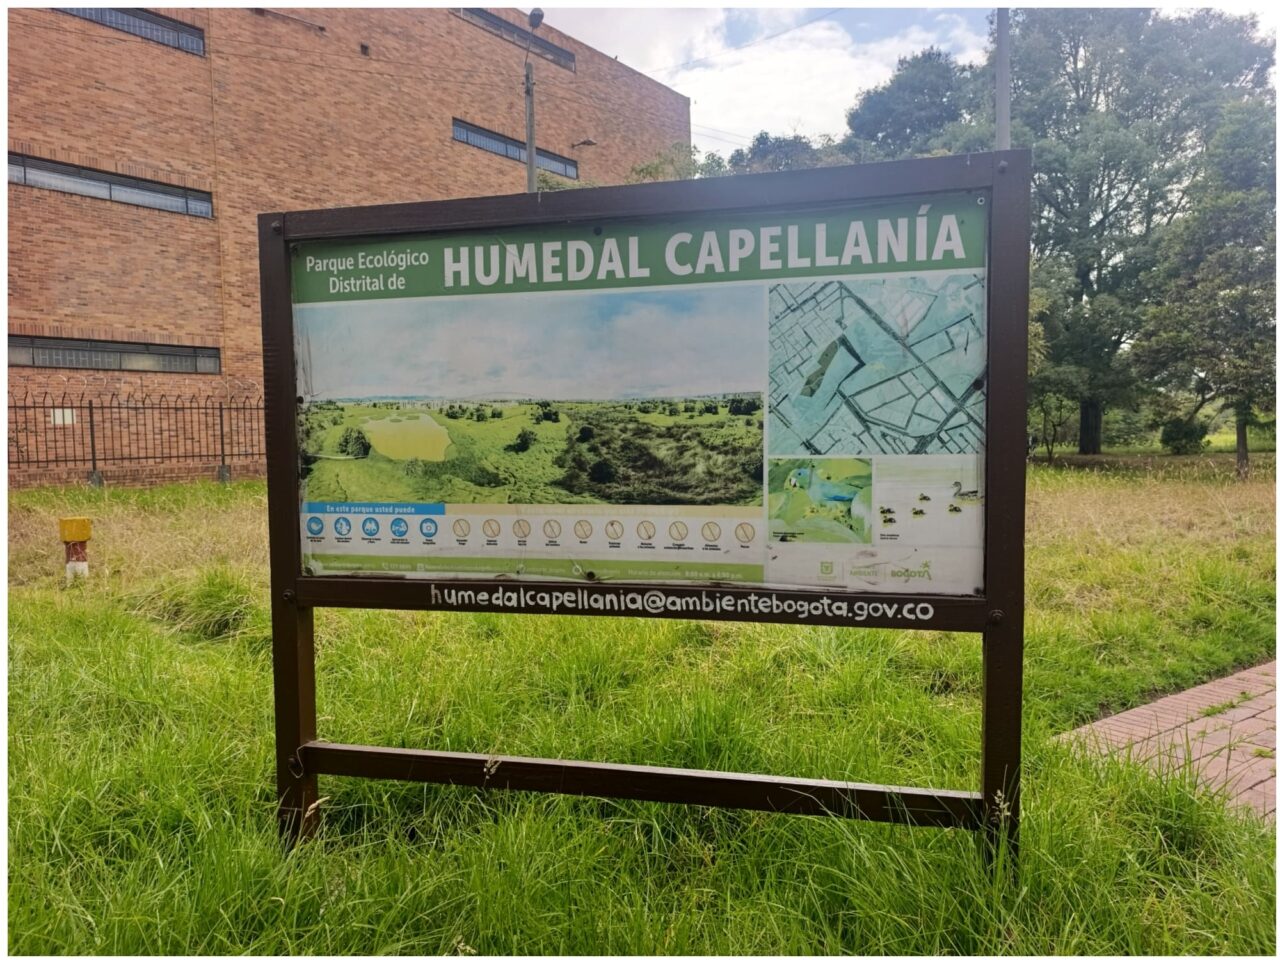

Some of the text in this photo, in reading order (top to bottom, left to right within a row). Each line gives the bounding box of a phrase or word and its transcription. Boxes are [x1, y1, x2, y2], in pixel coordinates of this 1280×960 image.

[443, 204, 966, 288] HUMEDAL CAPELLANÍA
[306, 249, 429, 272] Parque Ecológico
[329, 275, 406, 293] Distrital de
[351, 506, 373, 514] parque
[375, 505, 393, 513] usted
[431, 584, 934, 620] humedalcapellania@ambientebogota.gov.co
